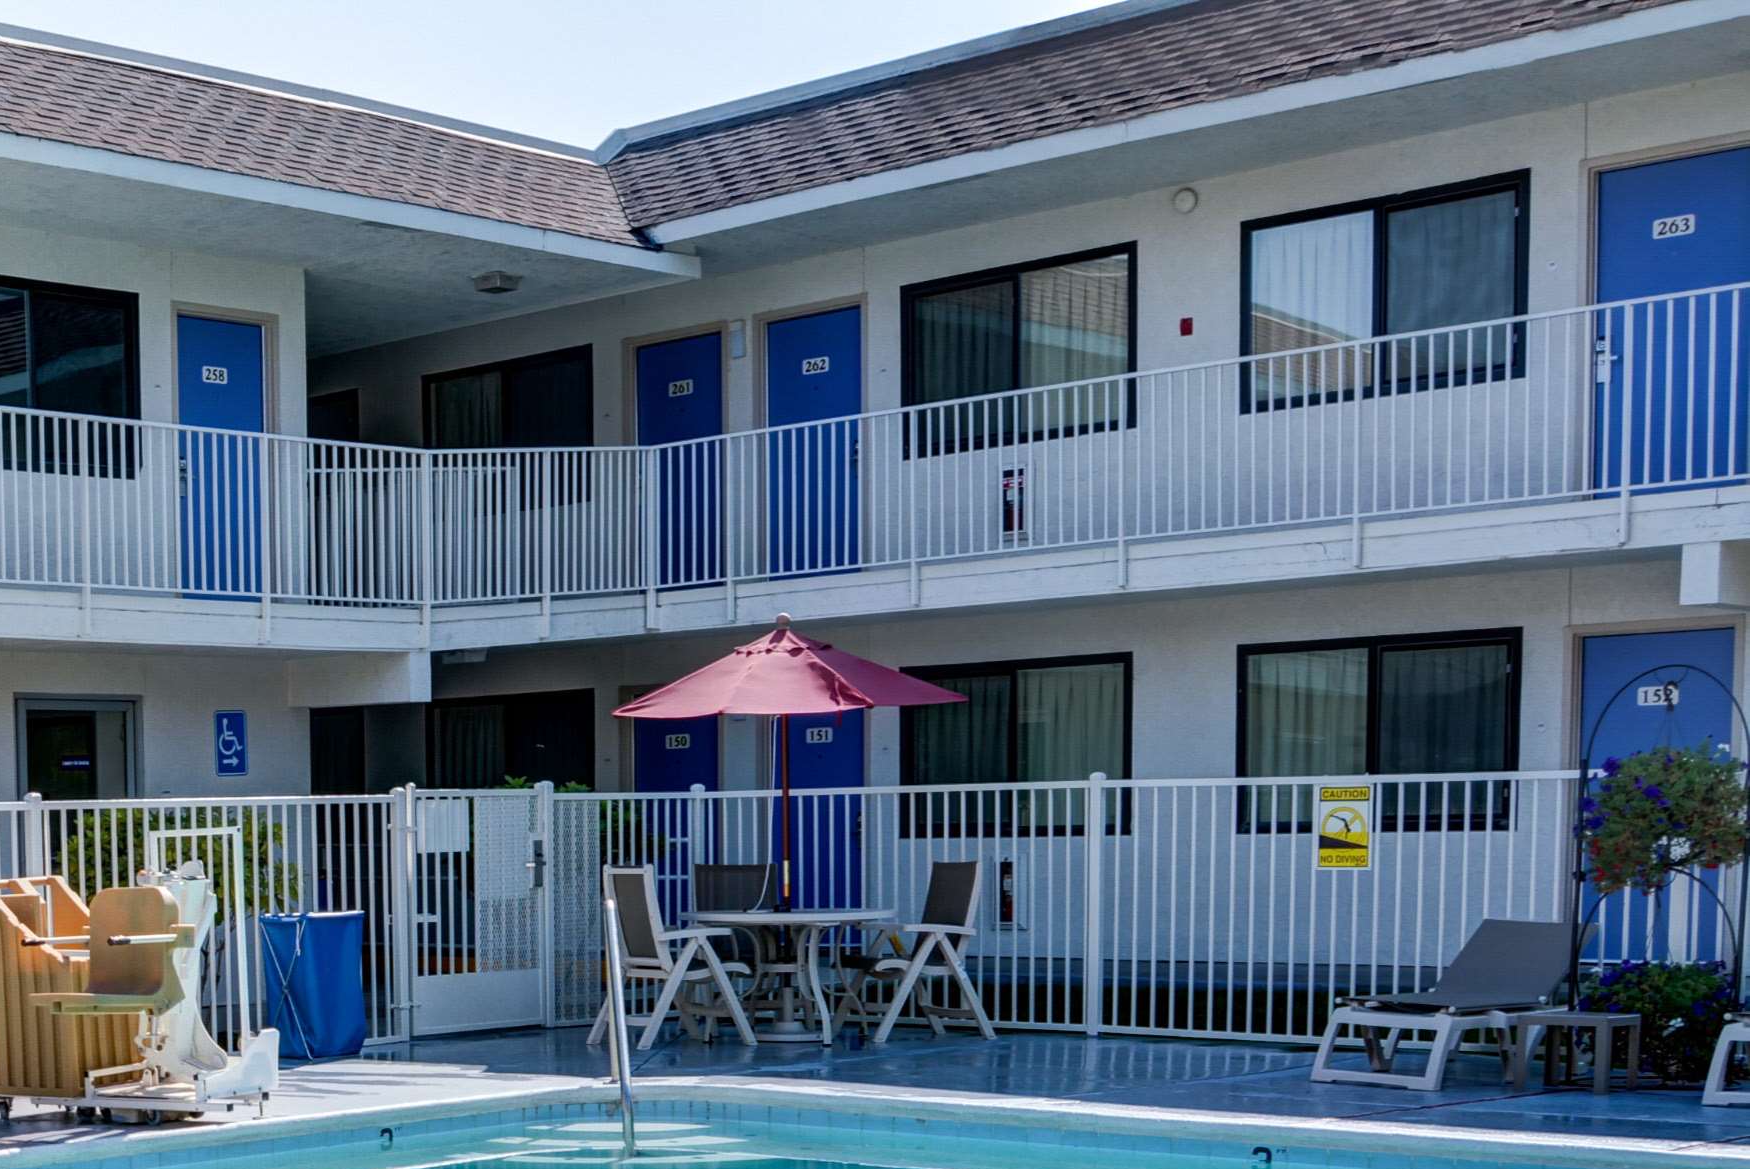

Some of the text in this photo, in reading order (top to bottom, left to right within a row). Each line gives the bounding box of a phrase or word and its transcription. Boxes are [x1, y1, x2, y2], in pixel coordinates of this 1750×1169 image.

[1657, 217, 1690, 236] 263
[805, 359, 826, 373] 262
[205, 368, 225, 382] 258
[671, 382, 691, 395] 261
[668, 735, 687, 748] 150
[809, 730, 829, 741] 151
[1322, 789, 1367, 799] CAUTION
[1320, 855, 1366, 864] NO DIVING
